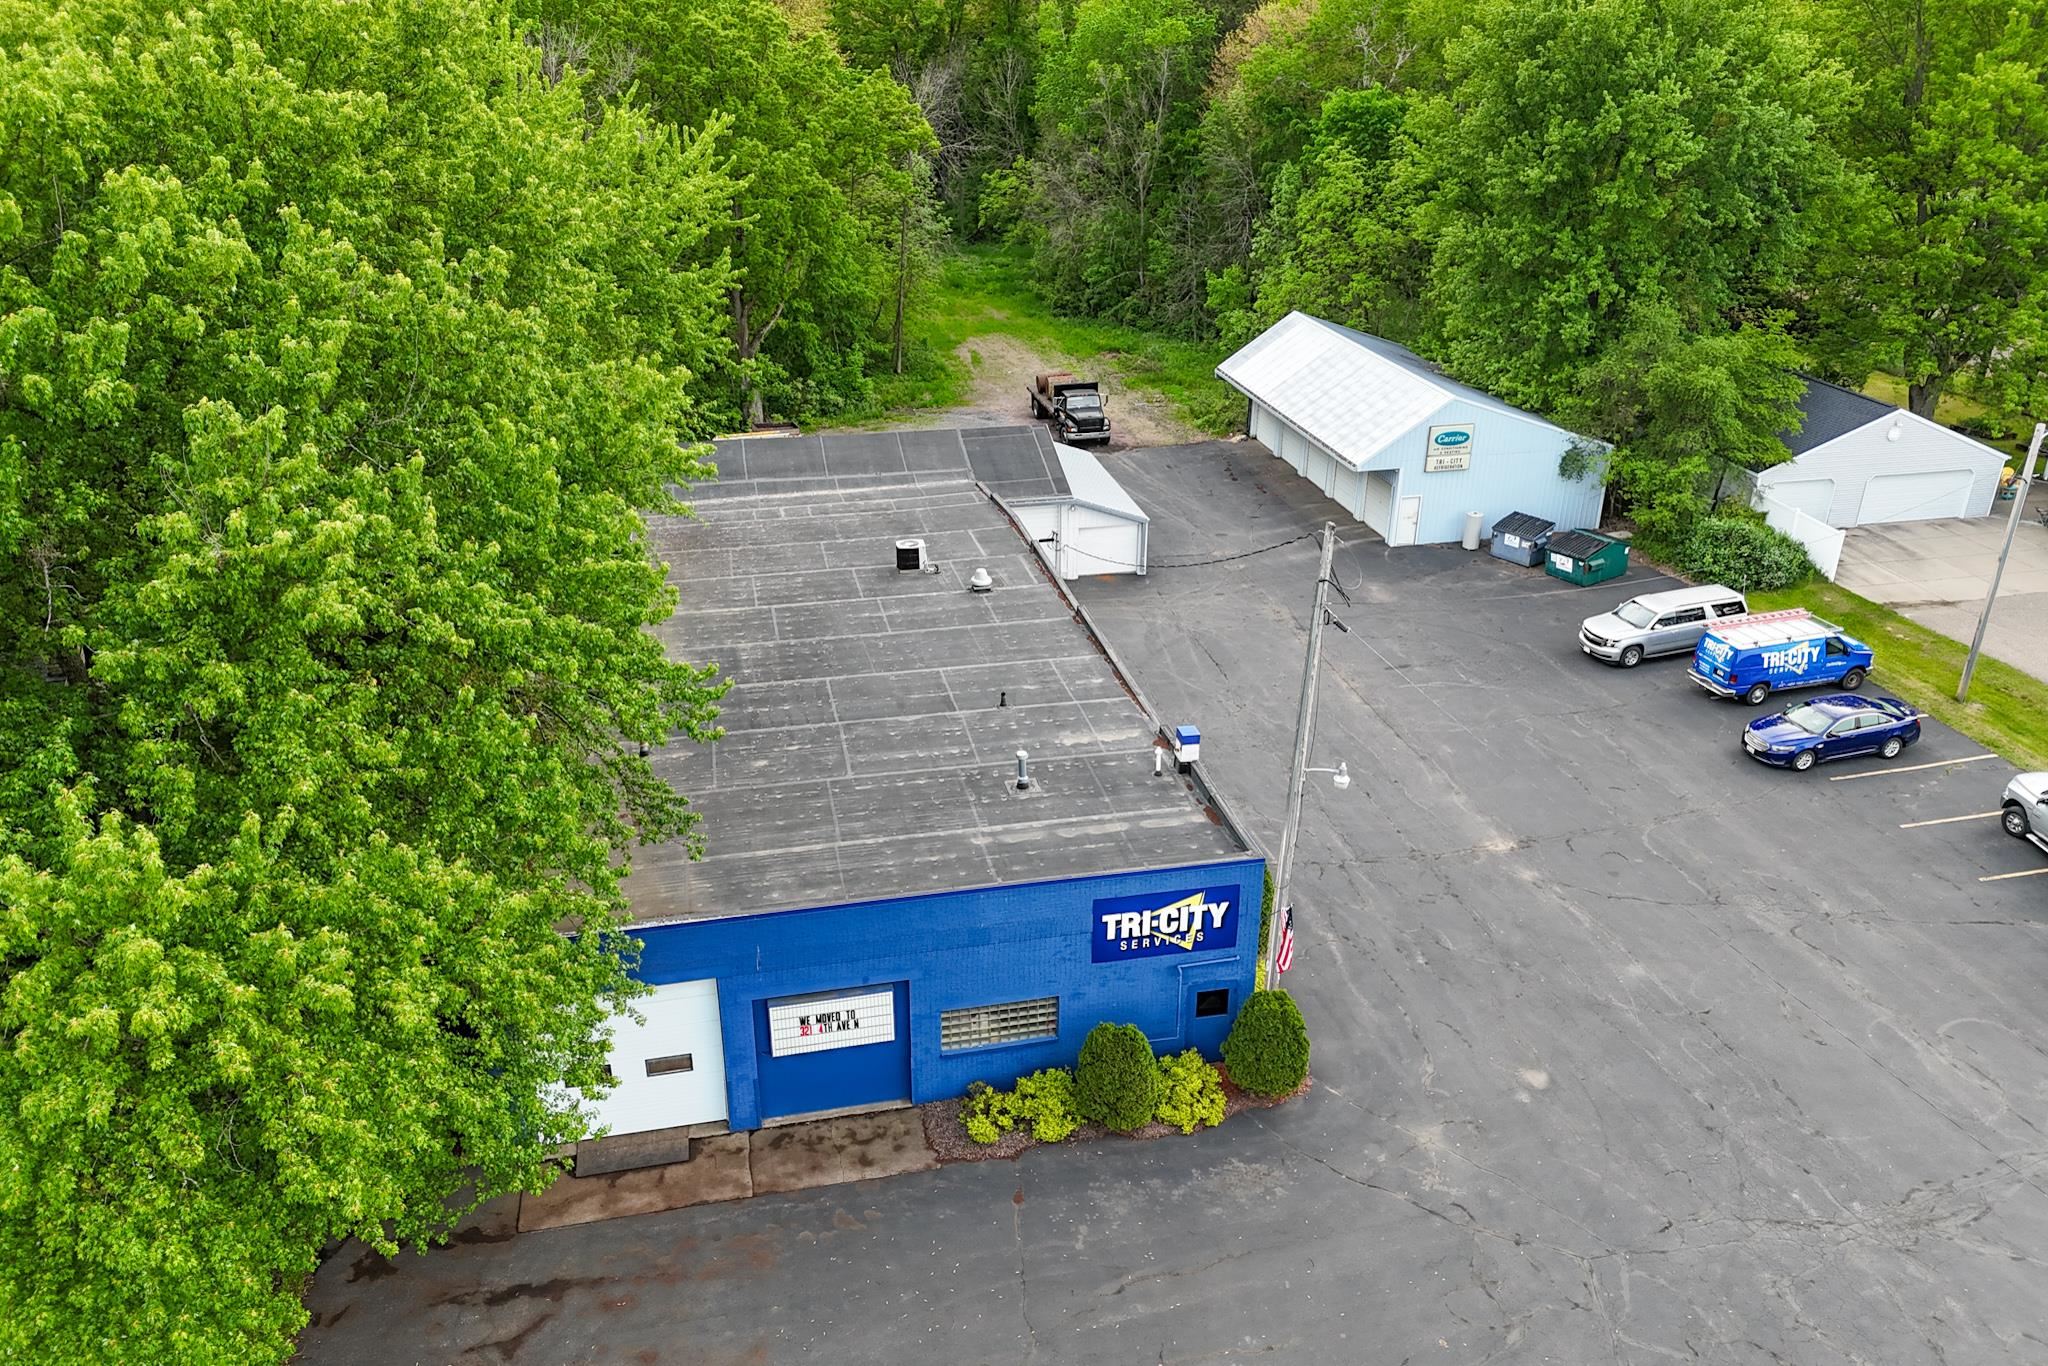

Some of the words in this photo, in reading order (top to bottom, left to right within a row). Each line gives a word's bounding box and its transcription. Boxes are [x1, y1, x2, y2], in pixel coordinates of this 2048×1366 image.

[1437, 434, 1467, 443] Carrier
[1761, 646, 1820, 669] TRI-CITY
[1101, 901, 1230, 941] TRI-CITY
[1120, 931, 1204, 951] SERVICES
[798, 1015, 811, 1027] WE
[815, 1011, 841, 1024] MOVED
[846, 1009, 856, 1020] TO
[800, 1025, 813, 1037] 321
[818, 1023, 833, 1034] 4TH
[836, 1020, 851, 1031] AVE
[854, 1019, 859, 1029] N
